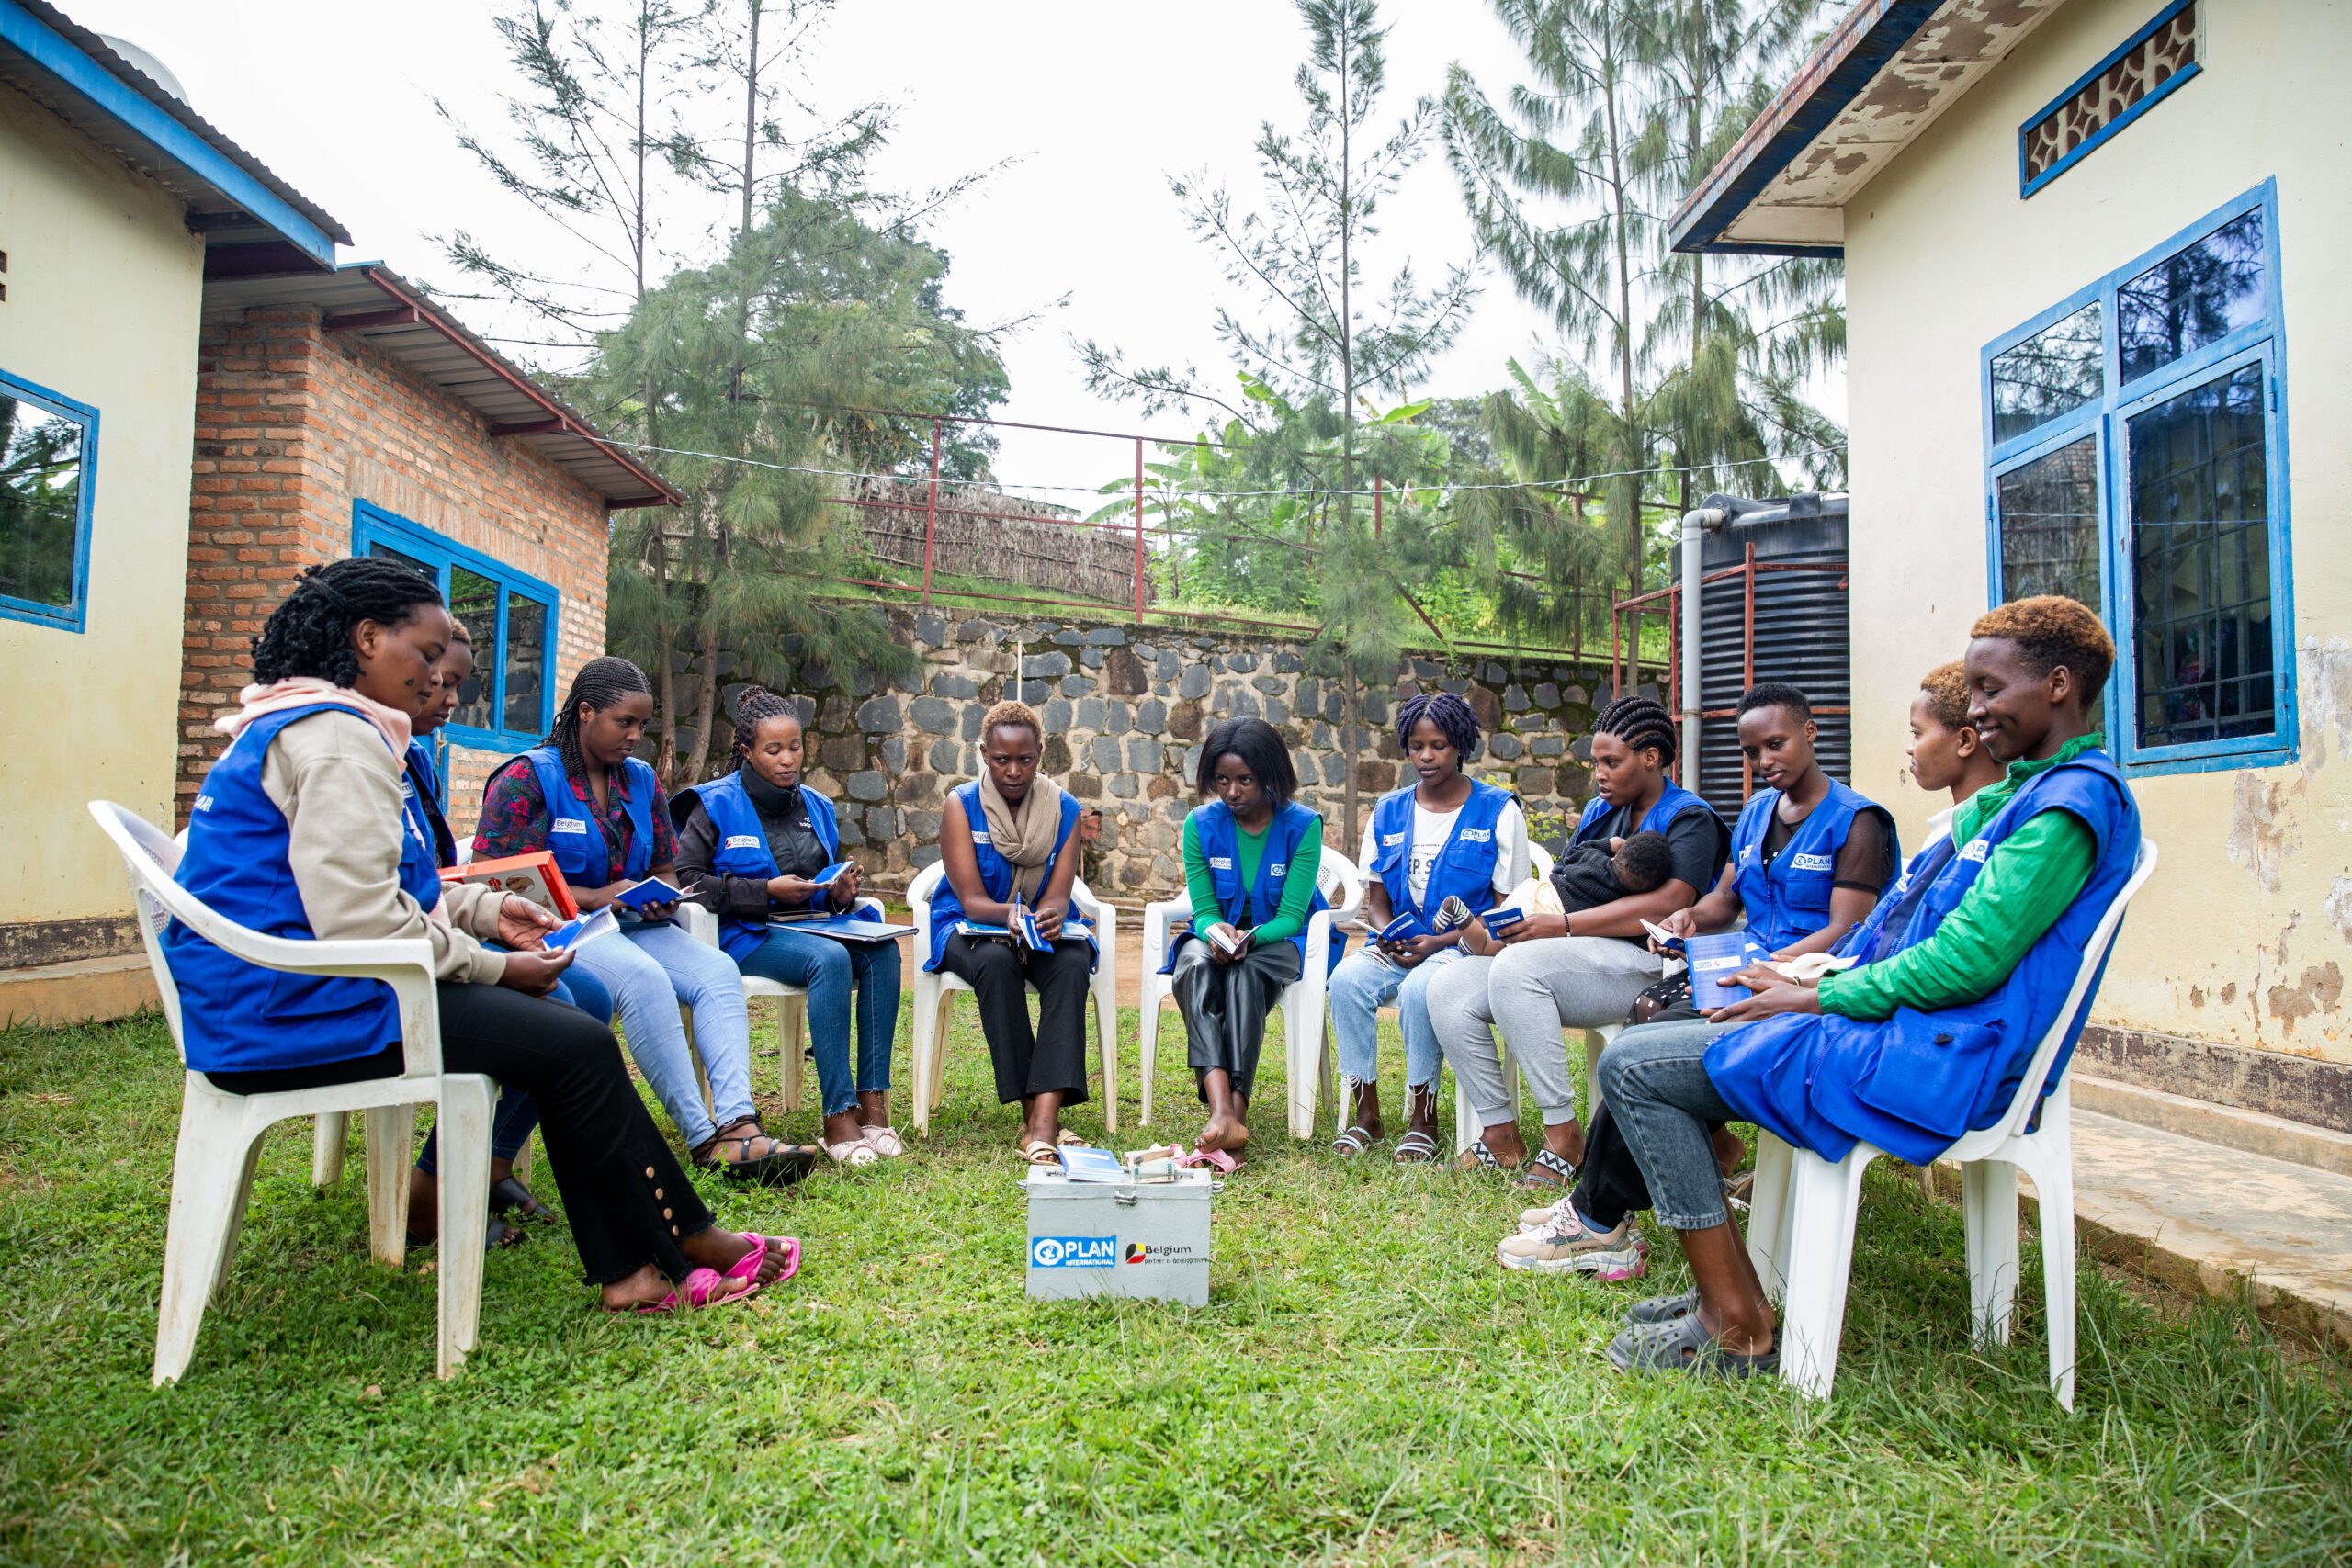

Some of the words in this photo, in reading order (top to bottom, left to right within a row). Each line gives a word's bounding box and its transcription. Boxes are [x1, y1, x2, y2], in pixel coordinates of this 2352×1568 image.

[556, 819, 582, 828] Belgium
[1807, 857, 1830, 865] PLAN
[1066, 1241, 1114, 1258] PLAN
[1145, 1245, 1192, 1256] Belgium
[1066, 1258, 1114, 1267] INTERNATIONAL
